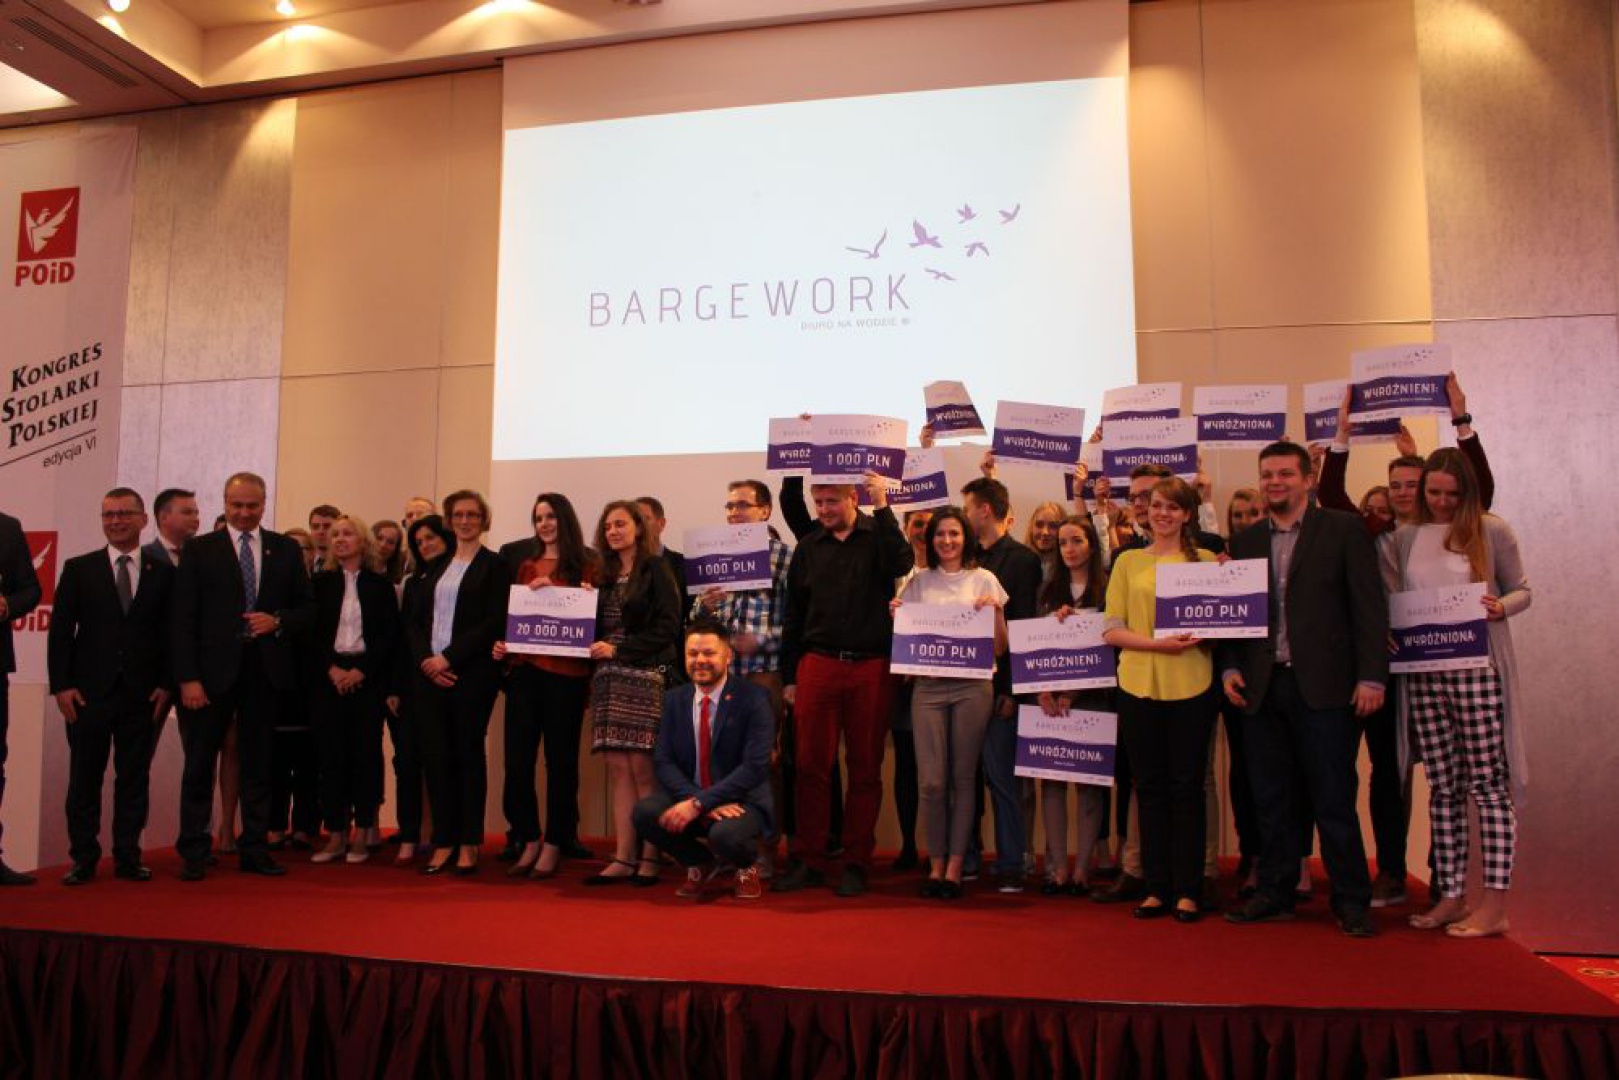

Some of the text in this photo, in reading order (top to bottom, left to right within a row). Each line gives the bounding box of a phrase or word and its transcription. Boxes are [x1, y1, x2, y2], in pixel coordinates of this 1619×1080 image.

[15, 262, 75, 287] POiD
[11, 341, 103, 393] KONGRES
[1, 369, 100, 423] STOLARKI
[8, 399, 99, 449] POLSKIEJ
[43, 444, 82, 468] edycja
[867, 454, 891, 468] PLN
[733, 560, 756, 573] PLN
[1220, 604, 1248, 618] PLN
[561, 626, 585, 639] PLN
[951, 645, 977, 660] PLN
